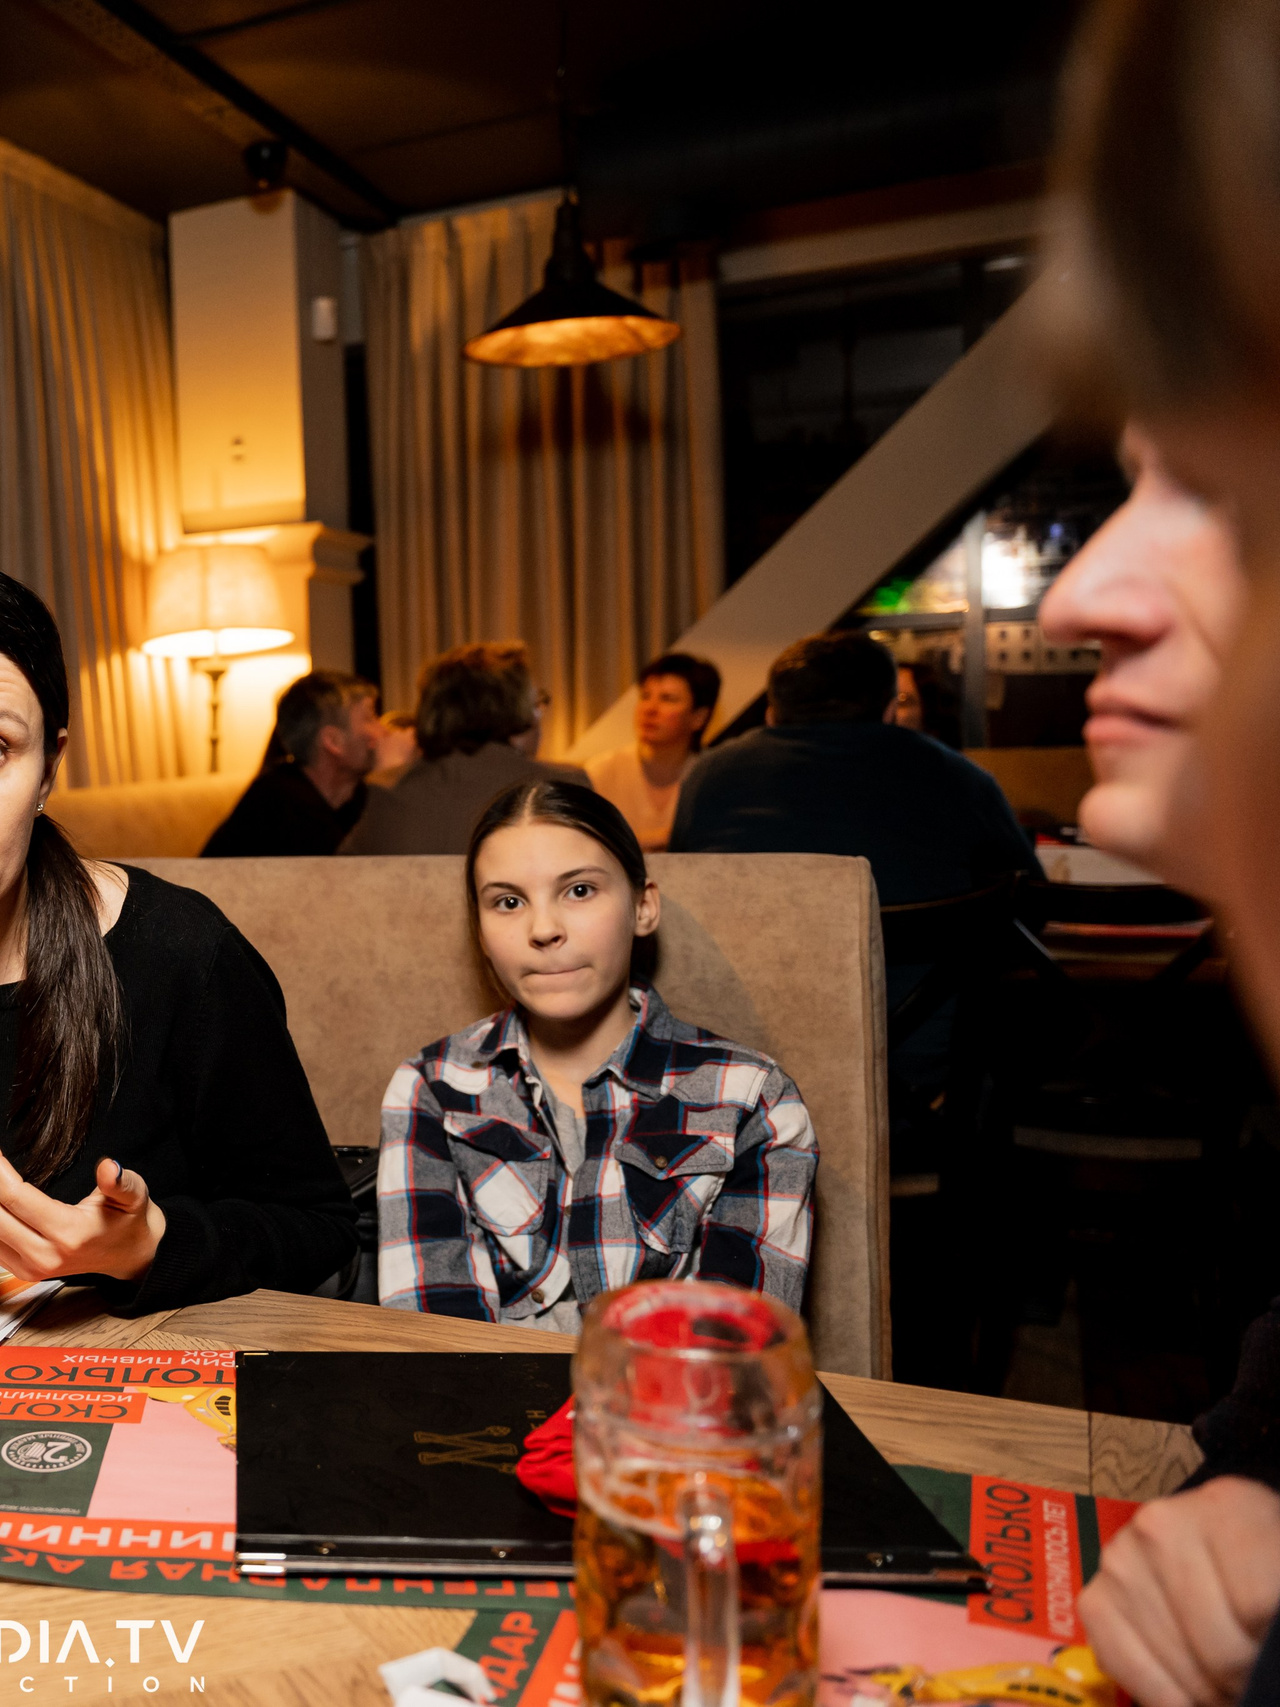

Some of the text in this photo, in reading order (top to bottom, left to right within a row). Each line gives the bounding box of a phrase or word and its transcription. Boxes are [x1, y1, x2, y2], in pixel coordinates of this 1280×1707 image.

[62, 1354, 173, 1366] ПИВНЫХ
[4, 1365, 235, 1385] ТОЛЬКО
[983, 1484, 1034, 1623] СКОЛЬКО
